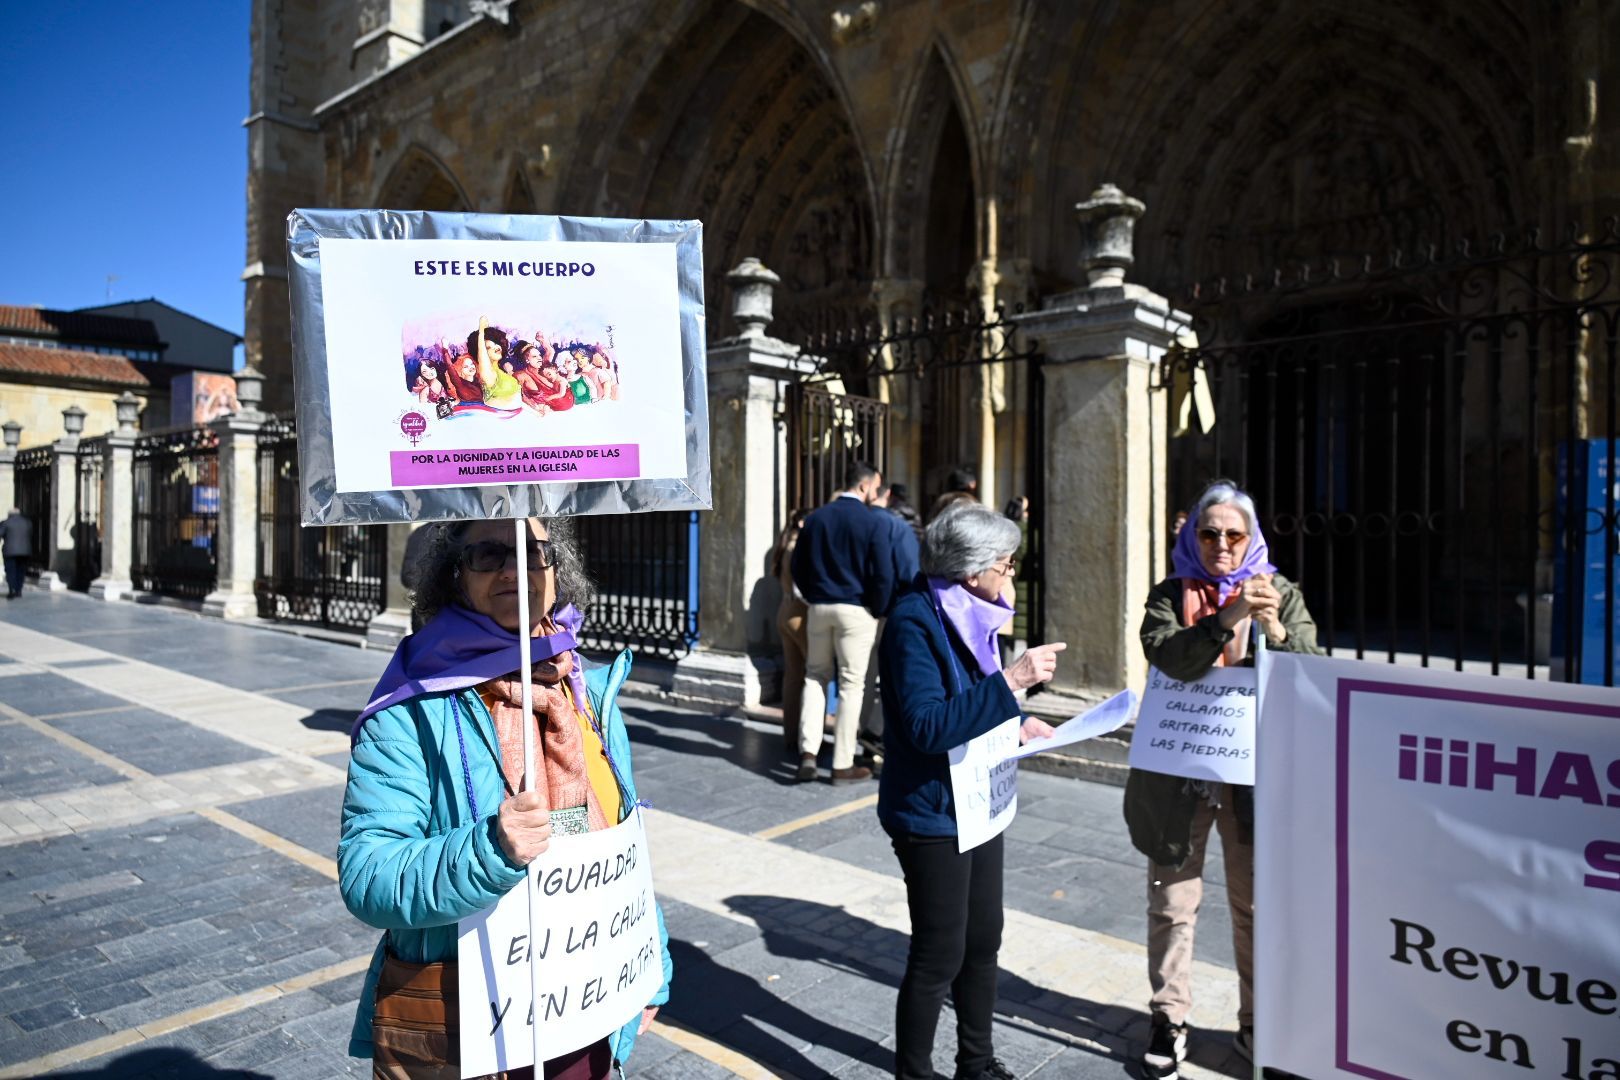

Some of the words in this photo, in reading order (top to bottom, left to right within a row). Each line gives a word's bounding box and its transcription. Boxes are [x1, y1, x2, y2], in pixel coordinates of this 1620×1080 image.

[414, 260, 462, 276] ESTE
[466, 261, 488, 276] ES
[492, 261, 514, 276] MI
[517, 262, 596, 277] CUERPO
[411, 454, 434, 464] POR
[436, 454, 450, 463] LA
[453, 452, 504, 463] DIGNIDAD
[506, 451, 513, 461] Y
[516, 451, 530, 460] LA
[531, 449, 584, 460] IGUALDAD
[586, 449, 599, 458] DE
[601, 448, 620, 458] LAS
[458, 465, 505, 476] MUJERES
[506, 465, 521, 474] EN
[523, 464, 536, 473] LA
[539, 463, 578, 472] IGLESIA
[1163, 680, 1186, 693] LAS
[1190, 683, 1256, 697] MUJERE
[1166, 700, 1246, 718] CALLAMOS
[1159, 719, 1236, 738] GRITARÁN
[1150, 737, 1176, 751] LAS
[1181, 742, 1251, 760] PIEDRAS
[1398, 733, 1620, 809] ¡¡¡HA
[536, 843, 638, 896] IGUALDAD
[506, 928, 551, 965] EN
[565, 920, 599, 954] LA
[609, 888, 647, 939] CALLE
[1389, 917, 1620, 1016] Revue
[489, 996, 512, 1037] Y
[581, 976, 608, 1011] EL
[617, 936, 655, 993] ALTAR
[1445, 1018, 1536, 1070] en
